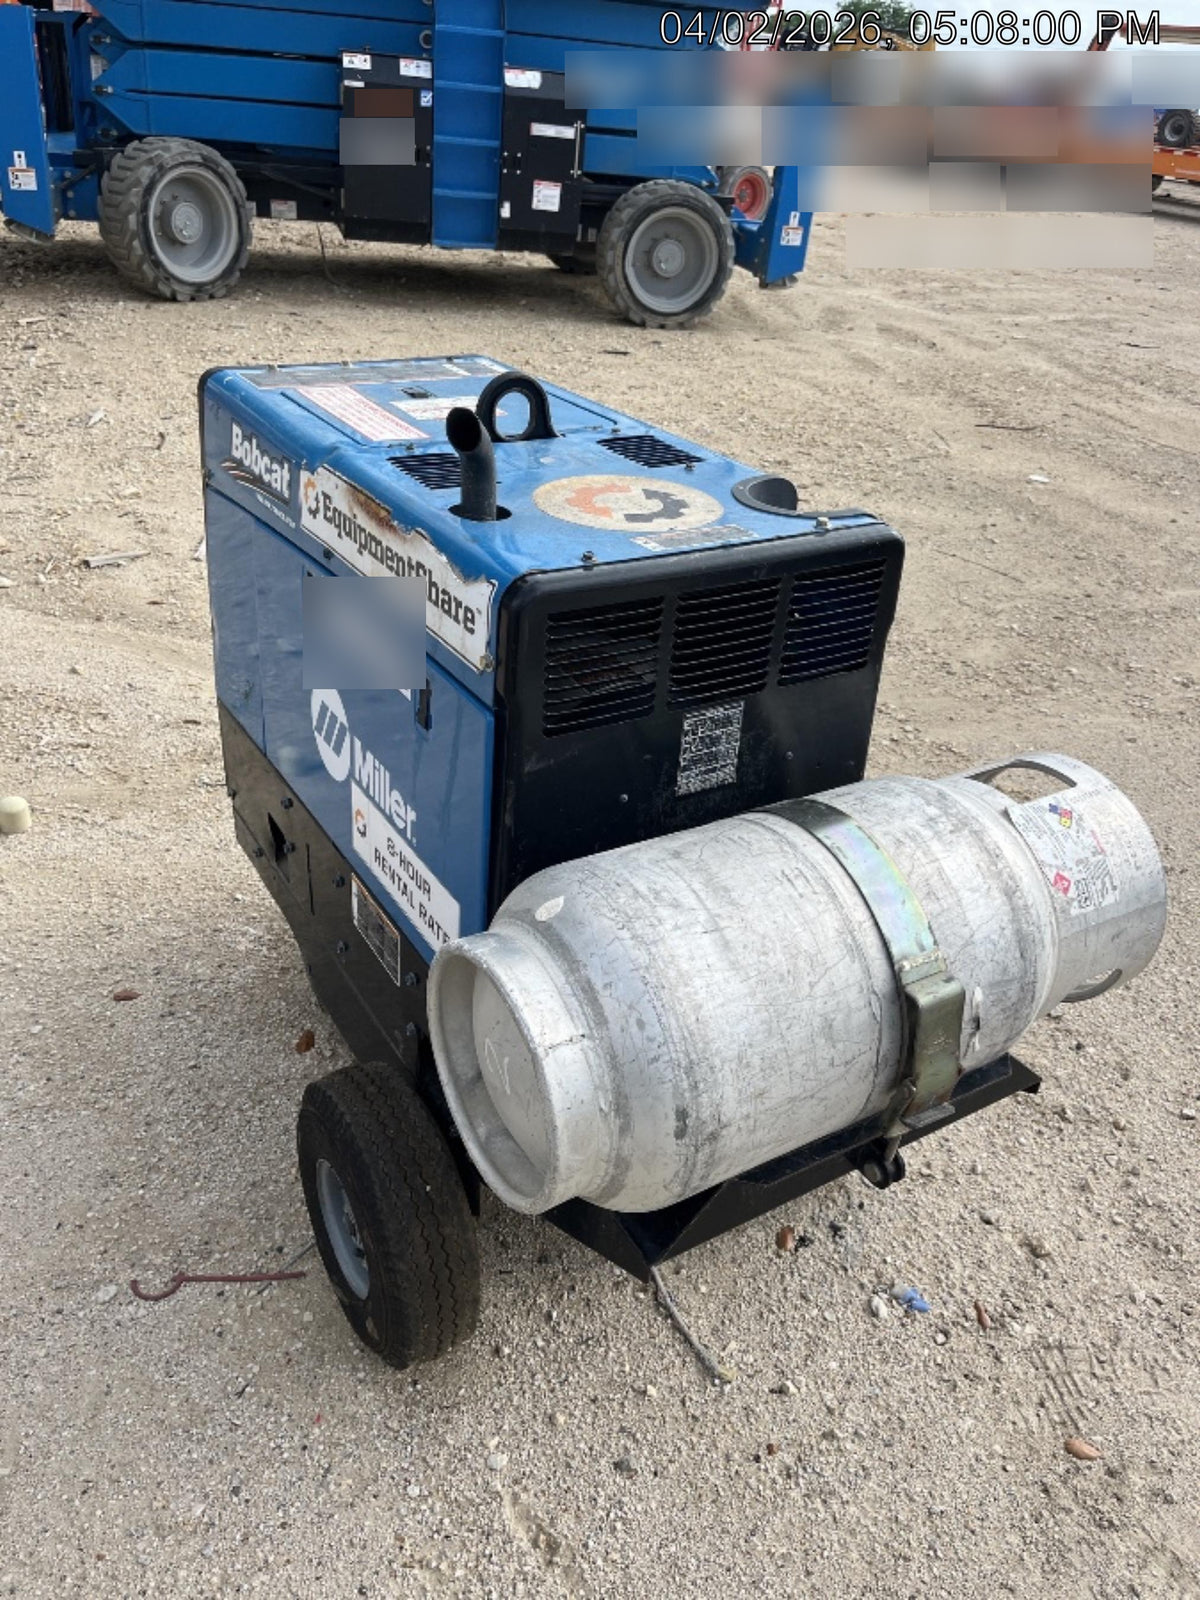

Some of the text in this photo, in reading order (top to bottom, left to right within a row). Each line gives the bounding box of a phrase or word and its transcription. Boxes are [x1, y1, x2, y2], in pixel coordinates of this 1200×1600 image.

[232, 421, 290, 499] Bobcat
[353, 736, 416, 840] Miller
[375, 846, 415, 909] RENTAL
